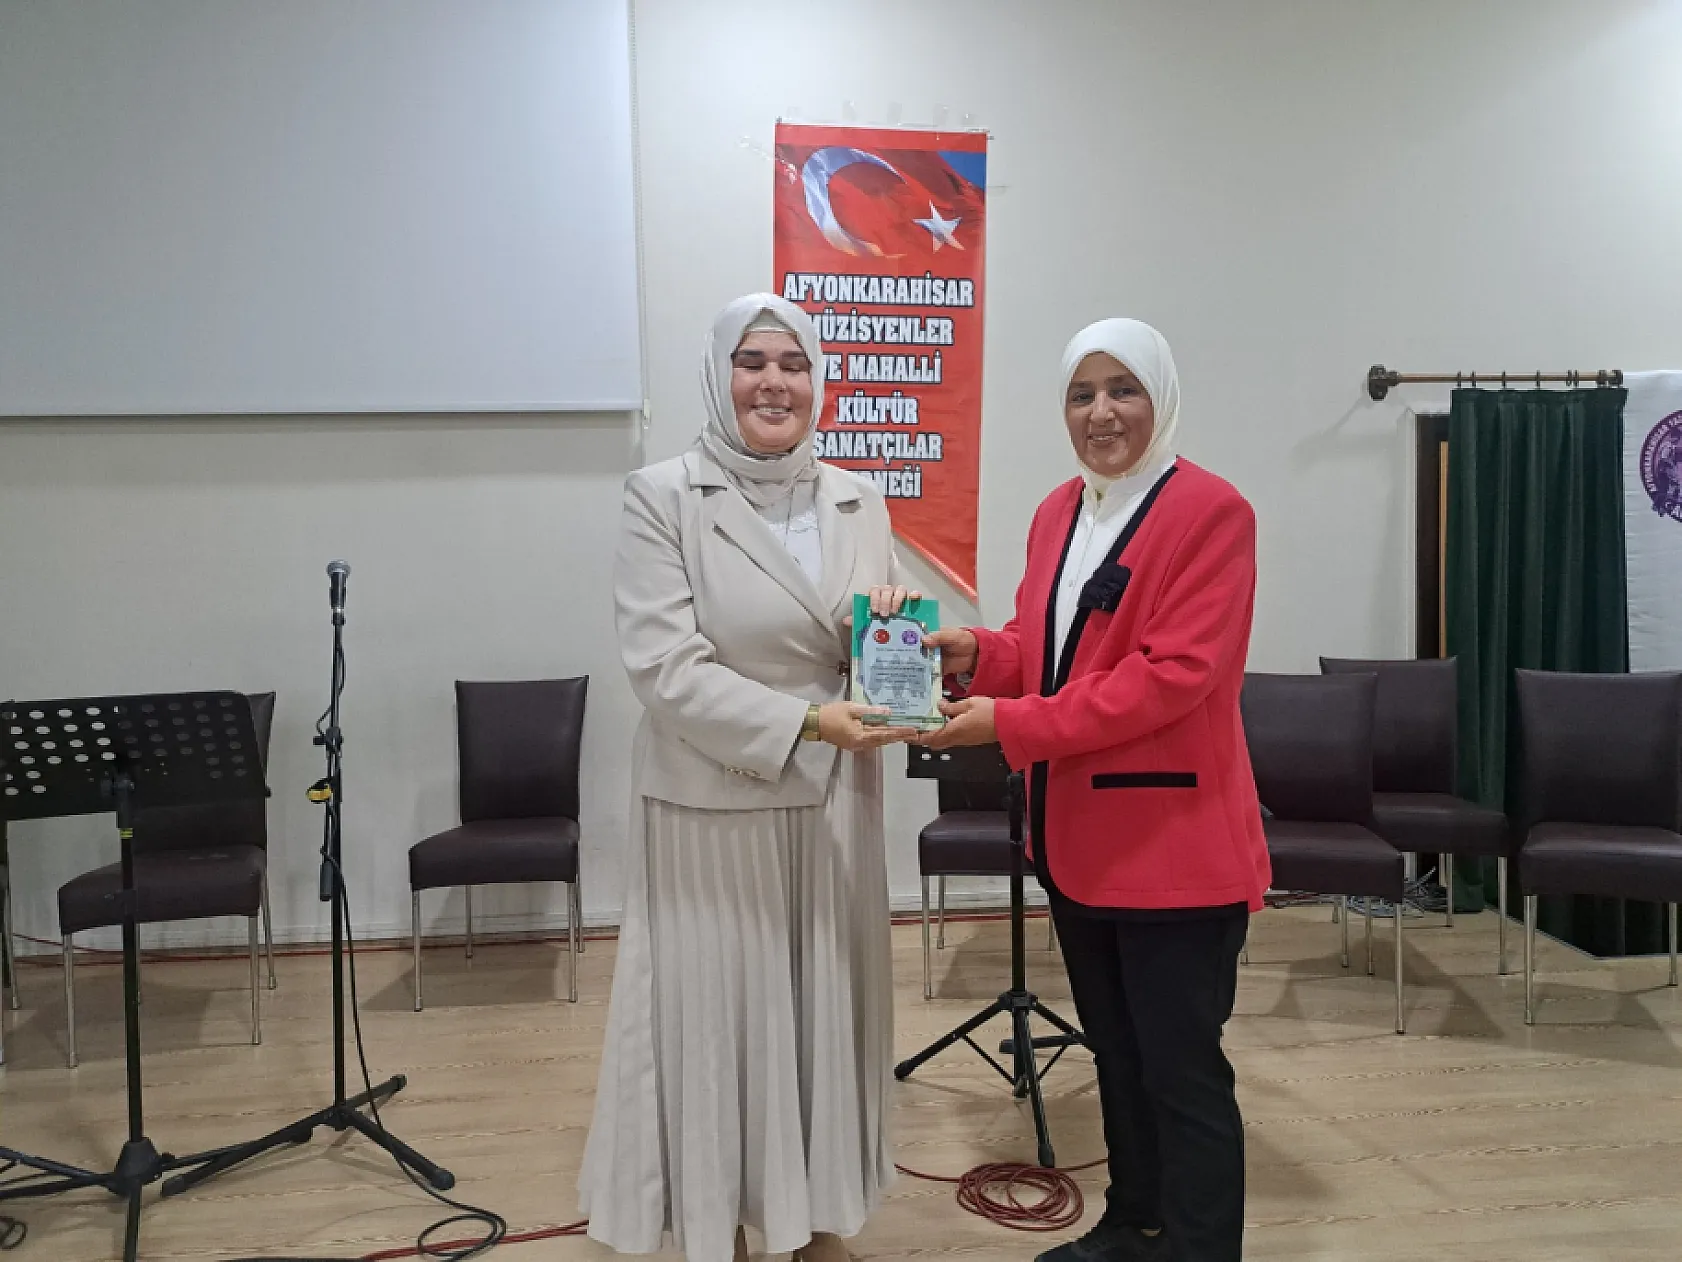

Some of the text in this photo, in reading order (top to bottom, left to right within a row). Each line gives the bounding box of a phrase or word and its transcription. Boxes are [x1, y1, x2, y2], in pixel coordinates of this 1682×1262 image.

[784, 271, 975, 307] AFYONKARAHİSAR
[847, 350, 942, 383] MAHALLİ
[838, 389, 919, 424] KÜLTÜR
[814, 430, 943, 465] SANATÇILAR
[858, 464, 922, 498] NEĞİ
